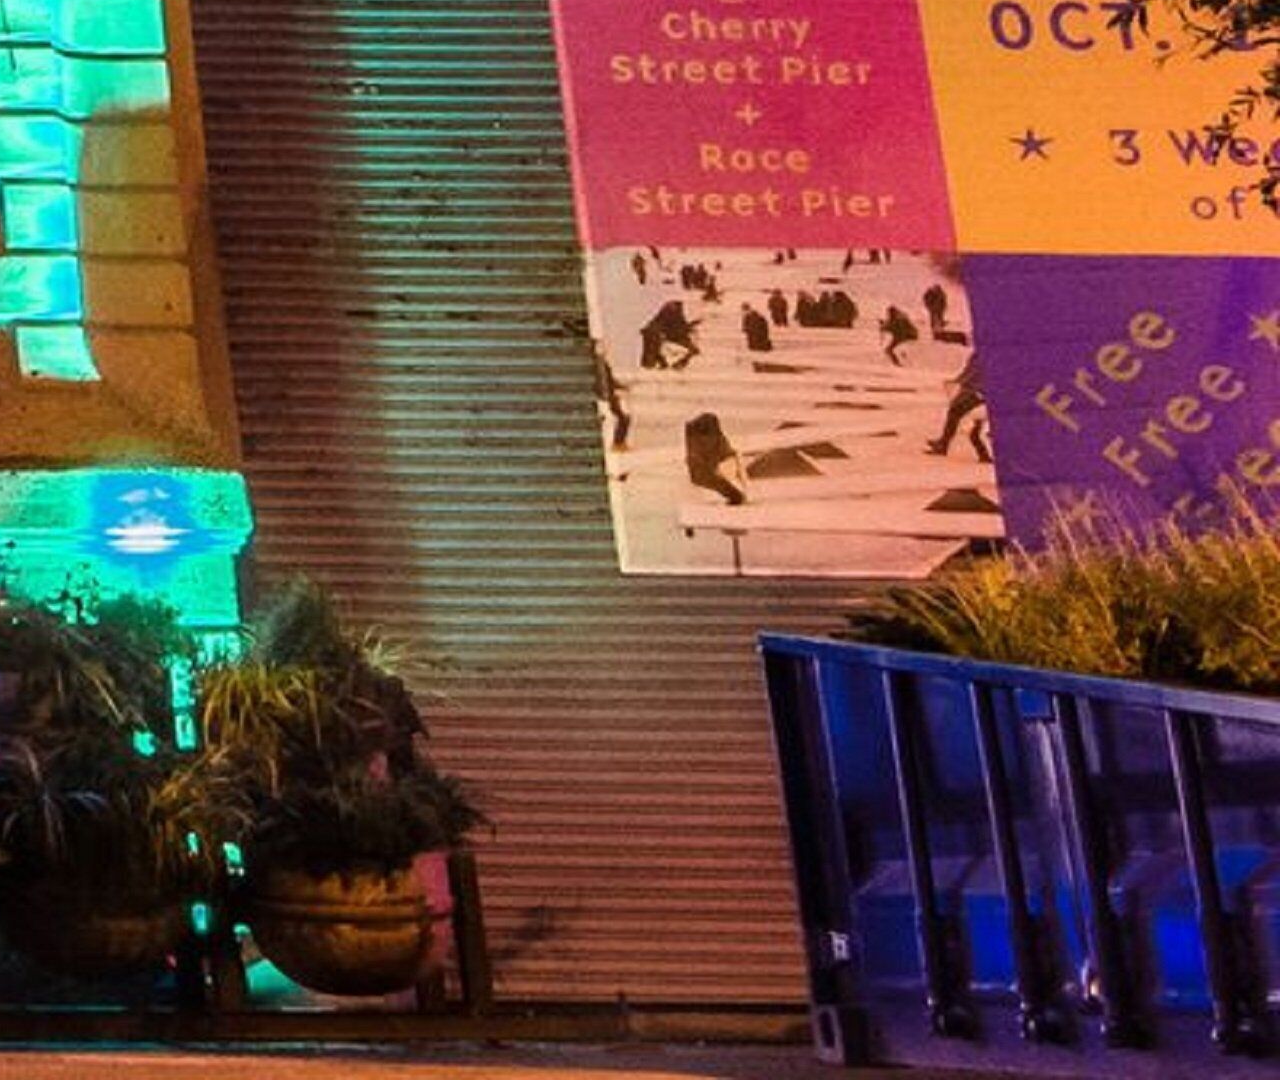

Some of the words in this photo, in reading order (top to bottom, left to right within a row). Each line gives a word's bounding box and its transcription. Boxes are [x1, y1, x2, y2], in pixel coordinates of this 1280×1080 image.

[661, 9, 812, 50] Cherry
[610, 53, 764, 85] Street
[781, 53, 872, 85] Pier
[699, 142, 811, 172] Race
[1109, 128, 1142, 166] 3
[627, 184, 782, 217] Street
[800, 184, 895, 219] Pier
[1191, 185, 1248, 220] of
[1035, 311, 1176, 433] Free
[1102, 364, 1246, 487] Free
